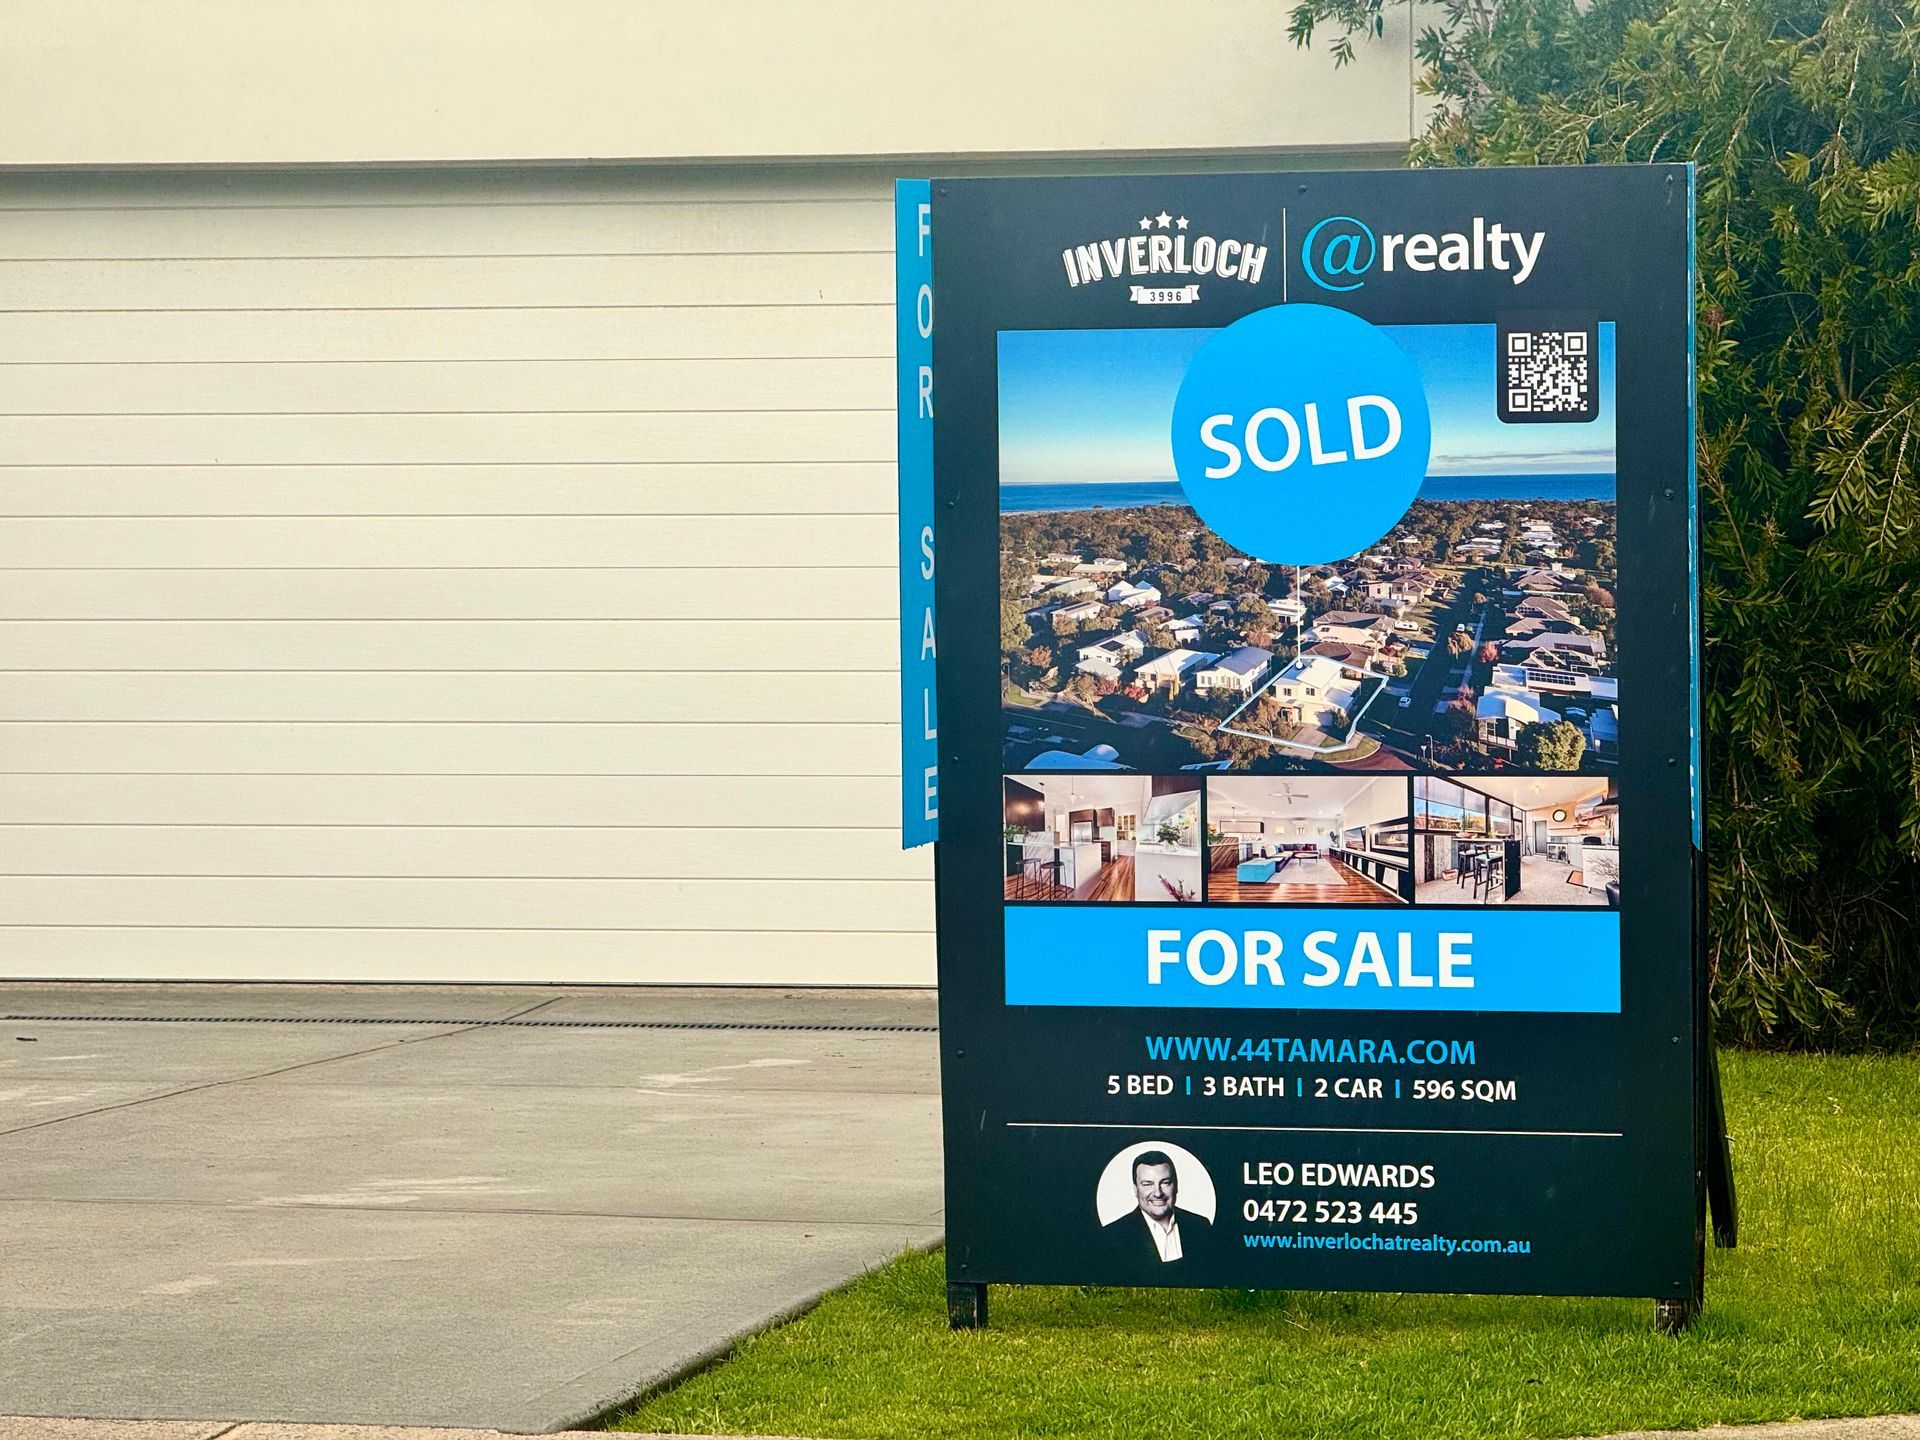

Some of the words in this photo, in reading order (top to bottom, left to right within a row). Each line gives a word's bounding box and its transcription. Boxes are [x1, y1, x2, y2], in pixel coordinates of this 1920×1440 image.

[1062, 235, 1268, 287] INVERLOCH
[1301, 216, 1546, 291] @realty
[917, 203, 934, 419] FOR
[1150, 291, 1182, 302] 3996
[1200, 394, 1402, 479] SOLD
[920, 525, 938, 821] SALE
[1147, 929, 1285, 986] FOR
[1303, 931, 1475, 988] SALE
[1145, 1036, 1476, 1065] WWW.44TAMARA.COM
[1107, 1075, 1120, 1095] 5
[1128, 1075, 1174, 1096] BED
[1203, 1076, 1217, 1096] 3
[1224, 1077, 1285, 1097] BATH
[1315, 1077, 1328, 1098] 2
[1334, 1078, 1383, 1099] CAR
[1412, 1079, 1456, 1100] 596
[1461, 1080, 1517, 1103] SQM
[1243, 1162, 1294, 1186] LEO
[1301, 1163, 1436, 1189] EDWARDS
[1243, 1199, 1308, 1223] 0472
[1315, 1200, 1362, 1224] 523
[1370, 1201, 1418, 1225] 445
[1243, 1231, 1531, 1257] www.inverlochatrealty.com.au
